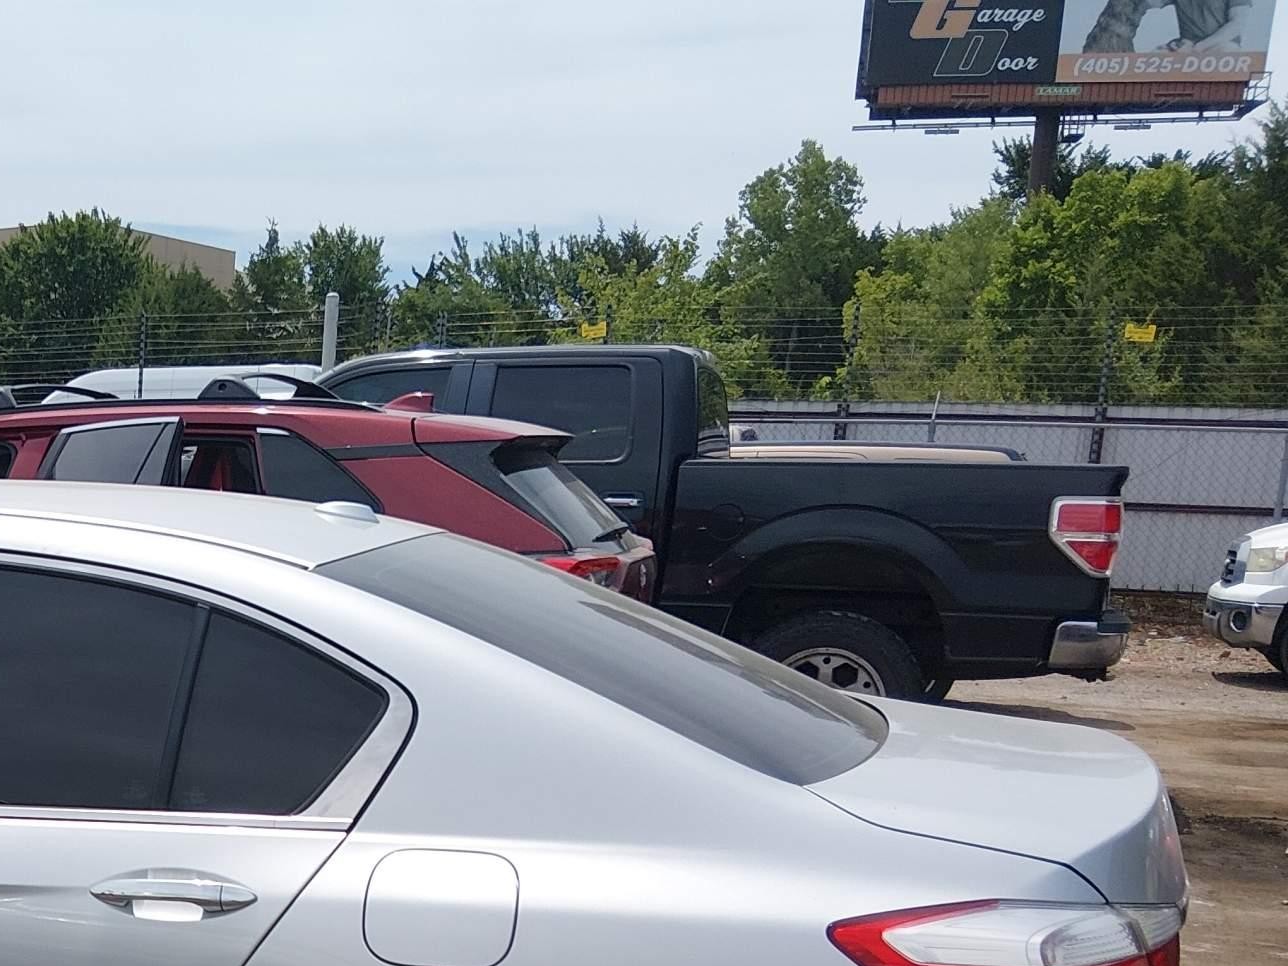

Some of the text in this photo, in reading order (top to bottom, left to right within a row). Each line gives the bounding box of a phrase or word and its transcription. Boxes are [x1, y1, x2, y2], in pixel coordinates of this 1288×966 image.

[910, 0, 1046, 39] Garage
[933, 29, 1039, 77] Door
[1073, 56, 1252, 76] (405) 525-DOOR
